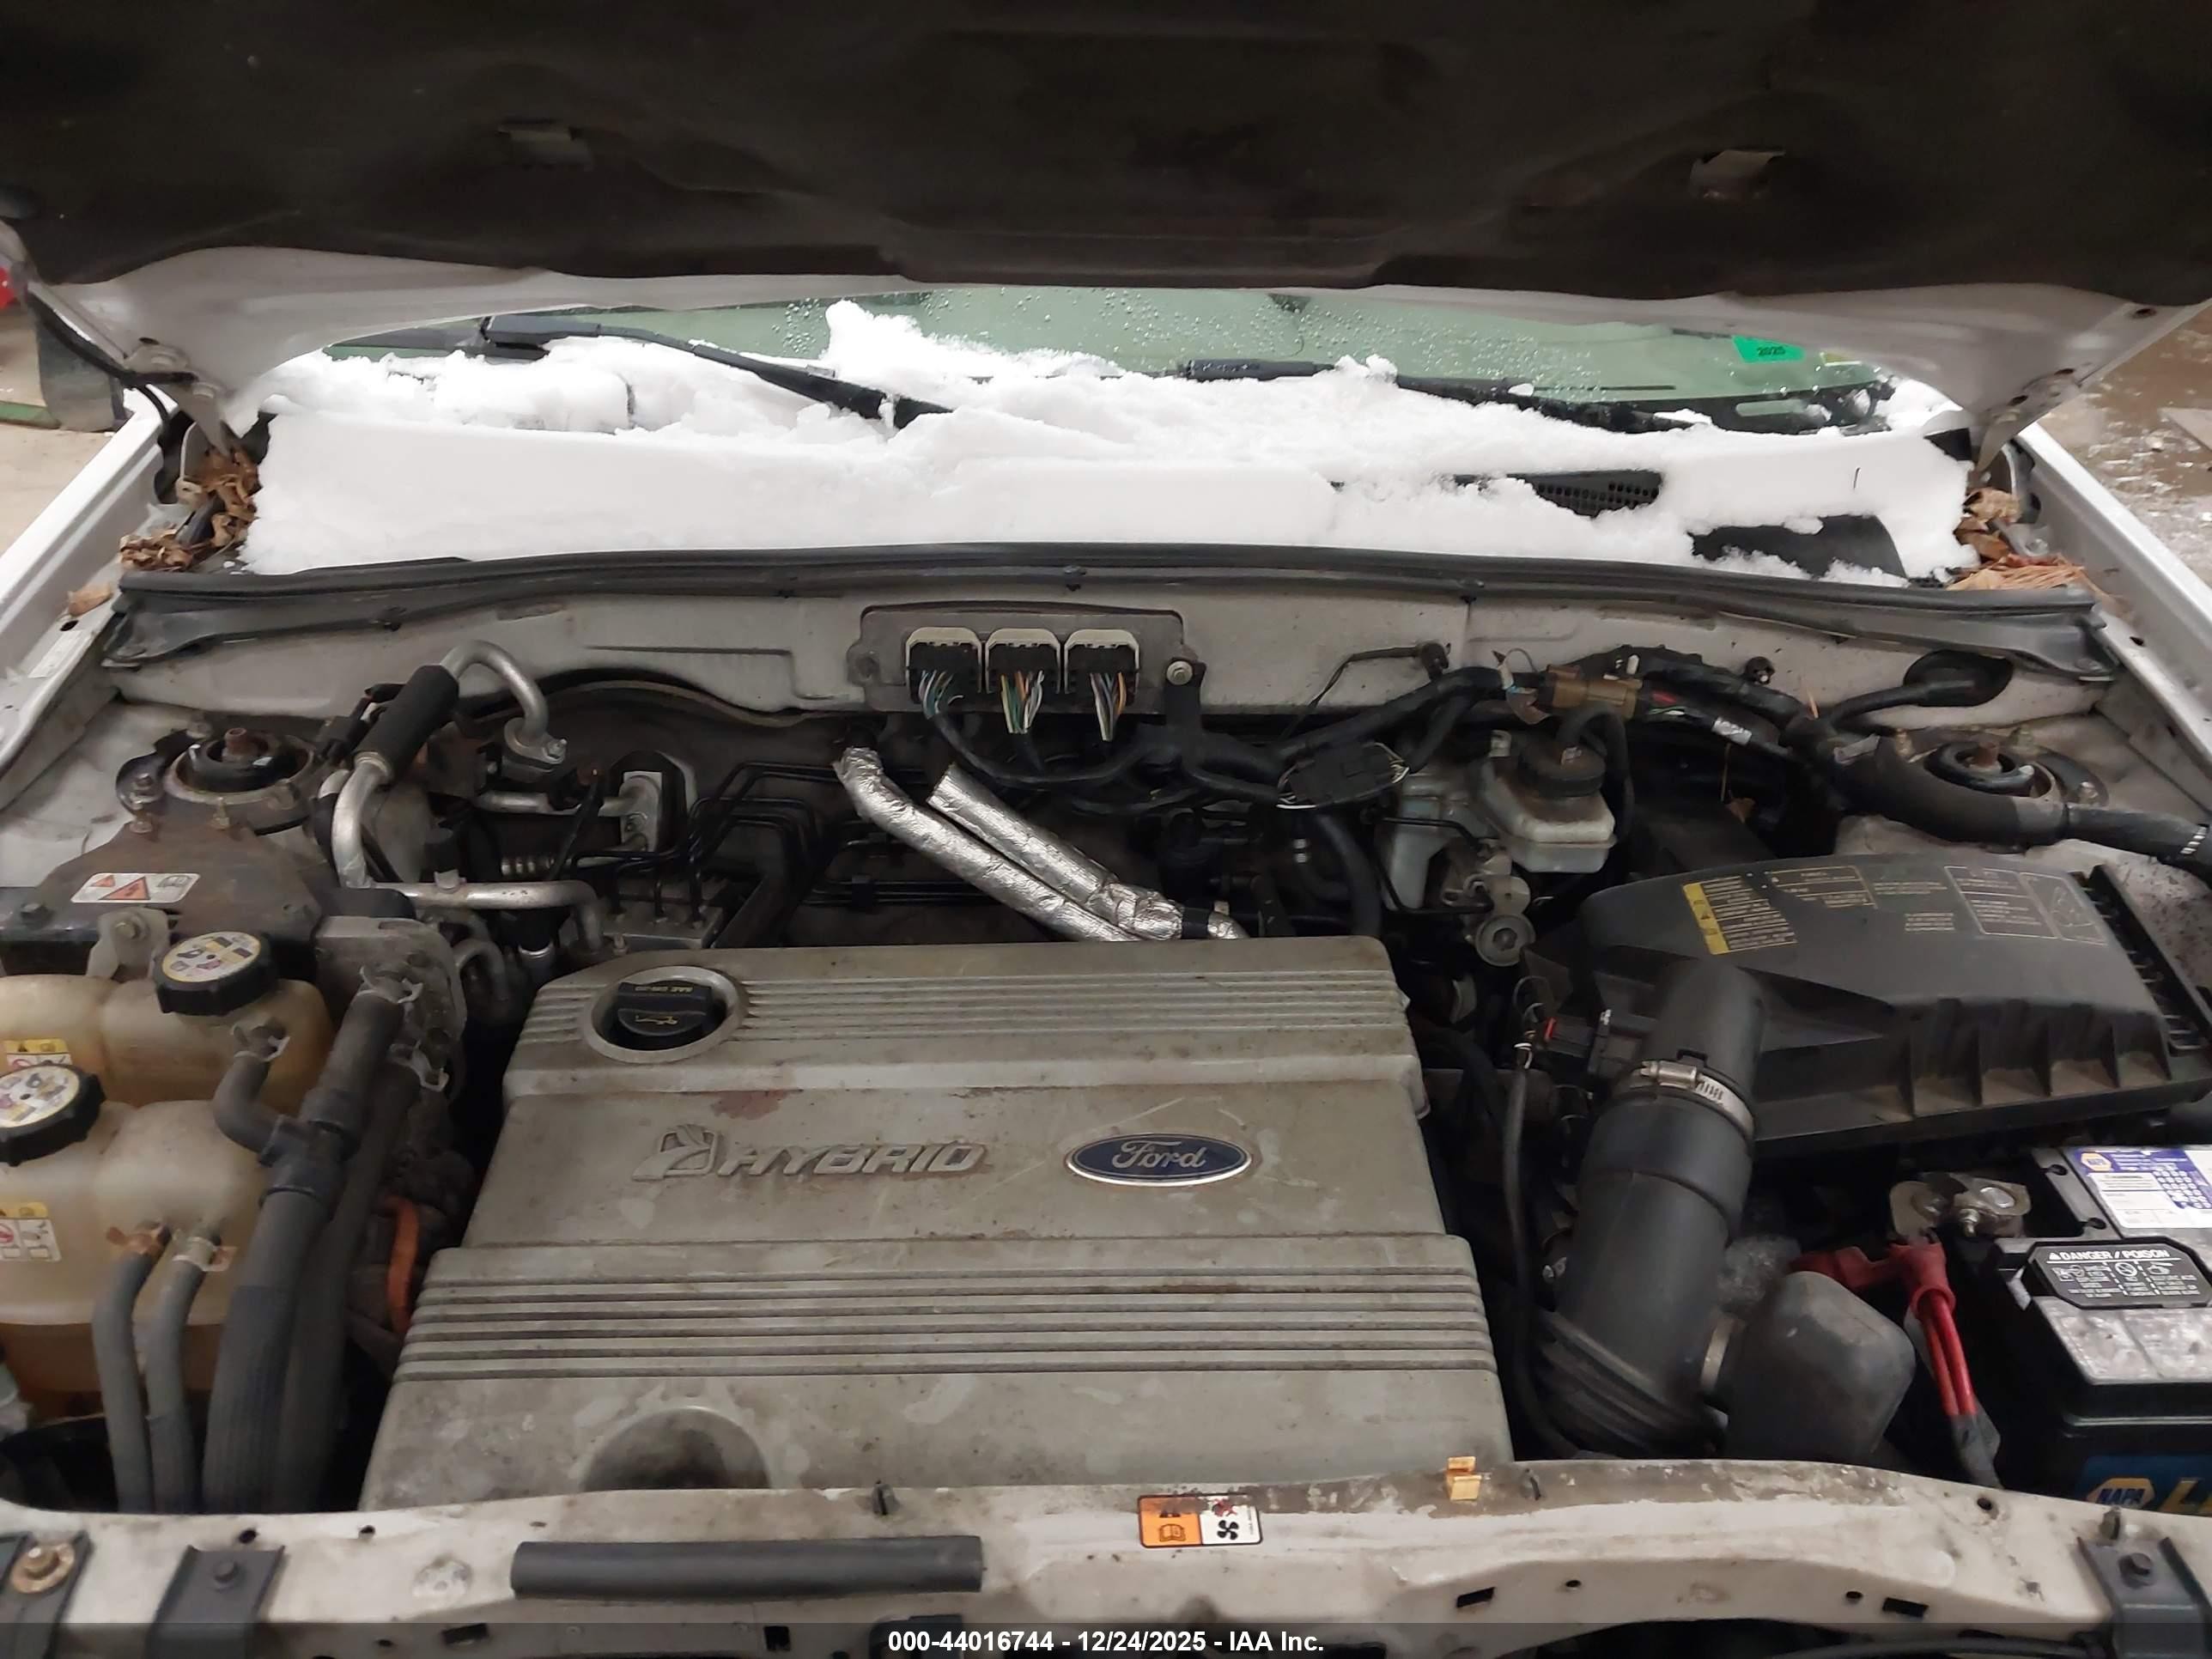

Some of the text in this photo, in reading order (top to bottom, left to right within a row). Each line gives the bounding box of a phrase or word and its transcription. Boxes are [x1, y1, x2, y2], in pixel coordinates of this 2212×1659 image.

[717, 1140, 986, 1176] HYBRID
[1112, 1139, 1208, 1169] Ford
[2060, 1251, 2112, 1261] DANGER
[2122, 1249, 2171, 1259] POISON
